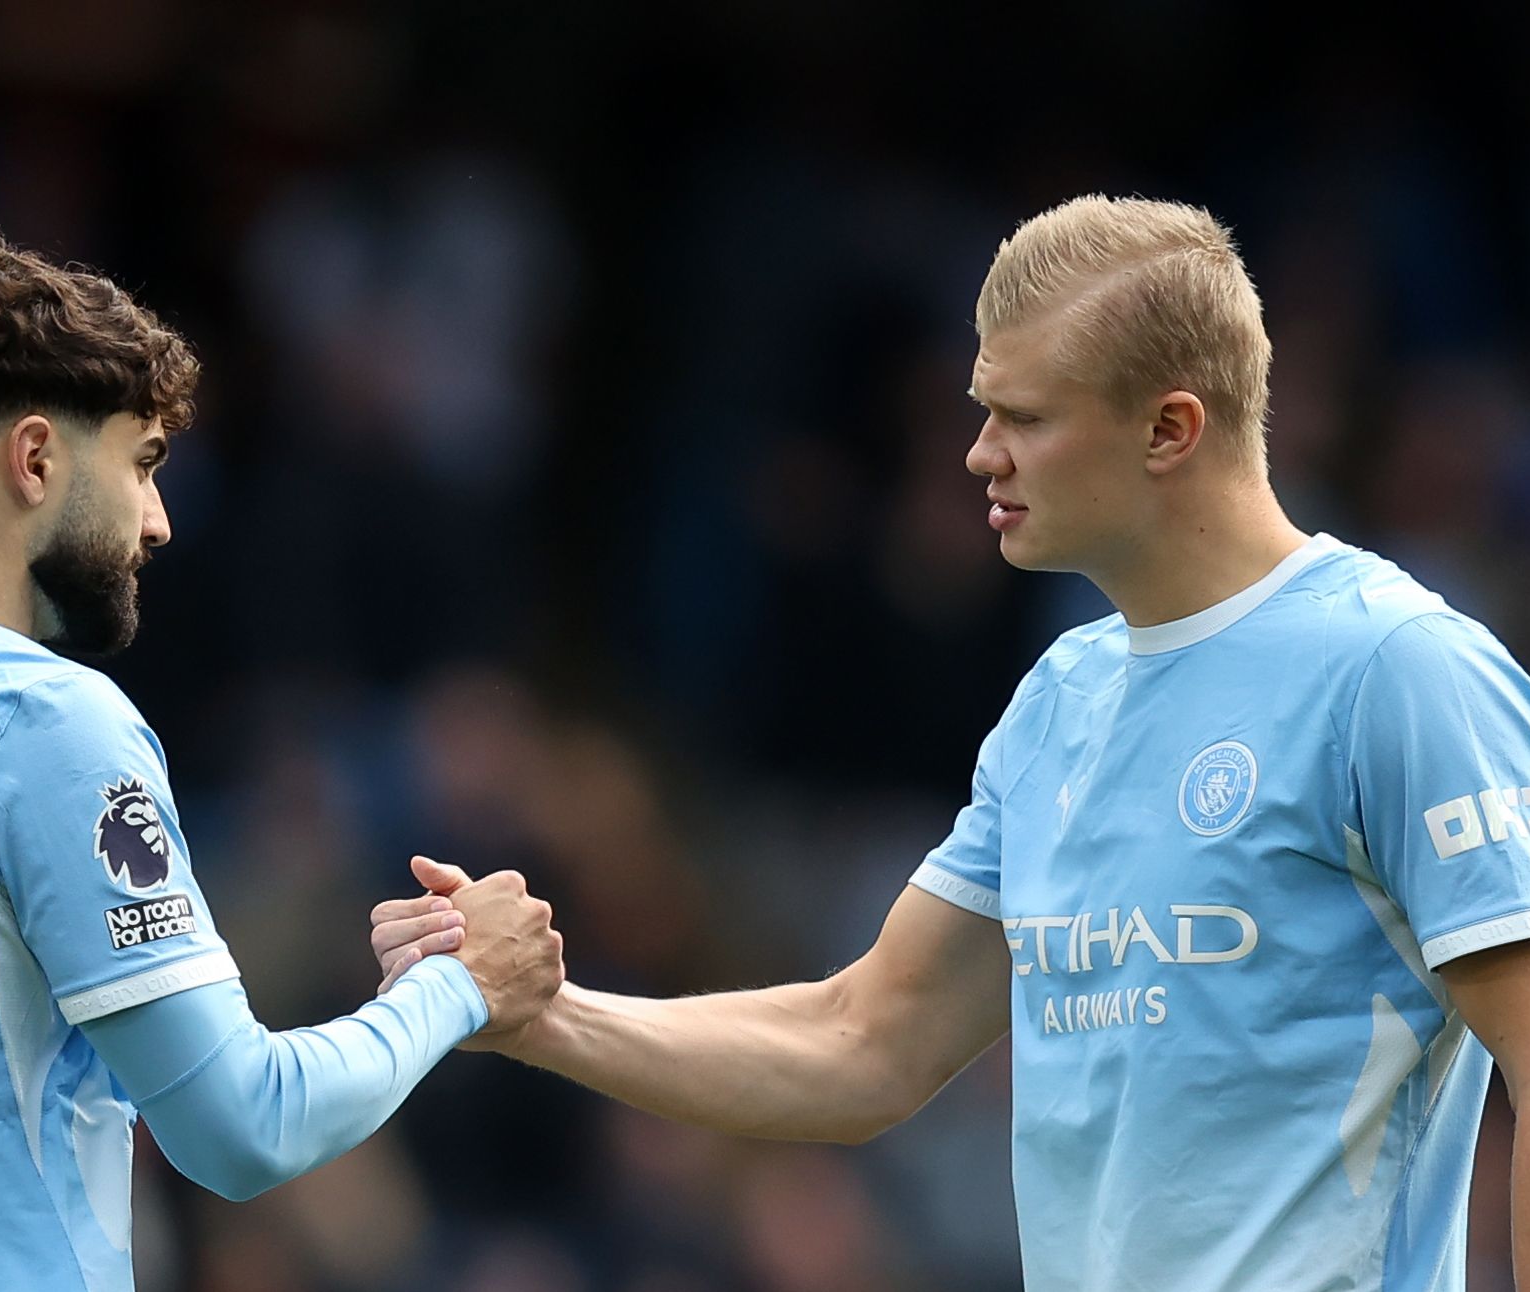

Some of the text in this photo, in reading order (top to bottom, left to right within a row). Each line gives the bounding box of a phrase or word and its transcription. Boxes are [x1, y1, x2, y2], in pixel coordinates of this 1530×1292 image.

[1194, 749, 1249, 778] MANCHESTER
[1198, 816, 1221, 827] CITY
[105, 898, 190, 931] No room
[111, 916, 198, 949] for racism
[1002, 905, 1259, 976] ETIHAD
[1044, 985, 1167, 1034] AIRWAYS
